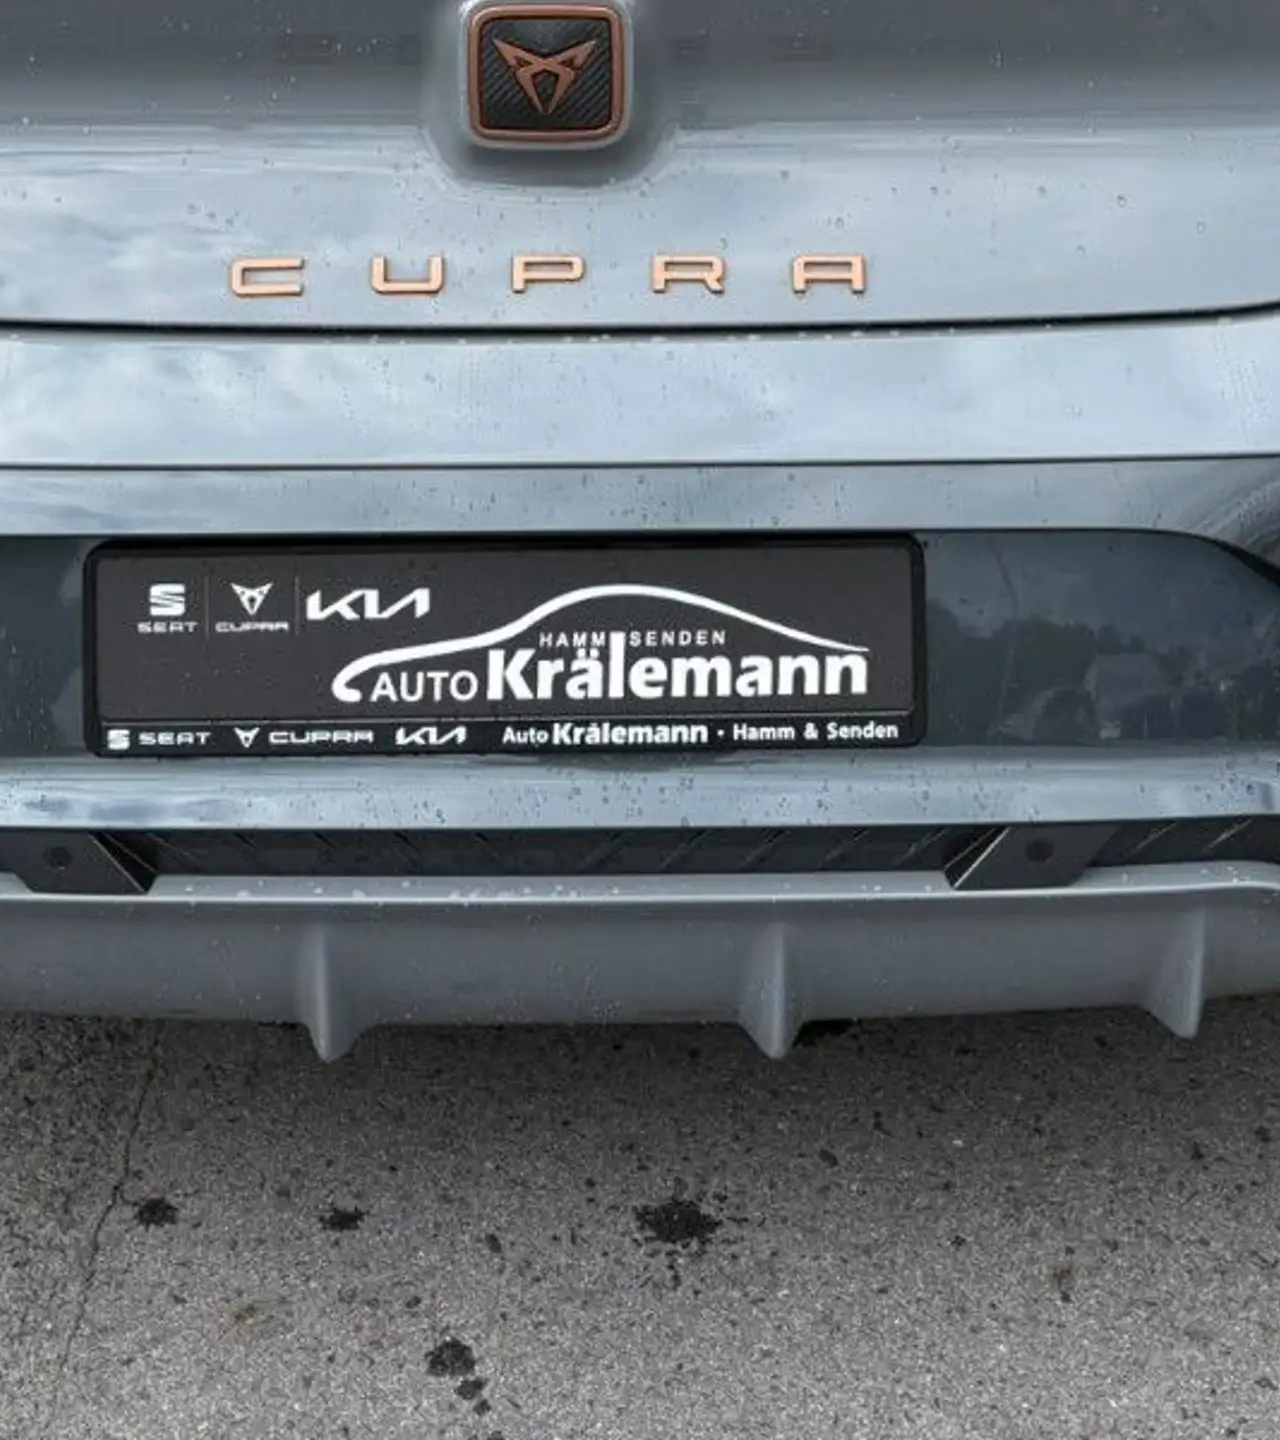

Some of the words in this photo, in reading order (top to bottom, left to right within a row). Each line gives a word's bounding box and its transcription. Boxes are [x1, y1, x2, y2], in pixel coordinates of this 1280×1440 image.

[229, 252, 868, 297] CUPRA
[306, 587, 431, 621] KIA
[138, 621, 198, 633] SEAT
[215, 621, 290, 632] CUPRA
[539, 631, 605, 648] HAMM
[628, 630, 726, 646] SENDEN
[369, 670, 479, 702] AUTO
[486, 631, 869, 701] Krälemann
[138, 731, 211, 746] SEAT
[268, 730, 375, 745] CUPRA
[502, 726, 549, 745] Auto
[552, 721, 708, 746] Krälemann
[733, 722, 795, 741] Hamm
[804, 723, 819, 740] &
[826, 721, 899, 740] Senden
